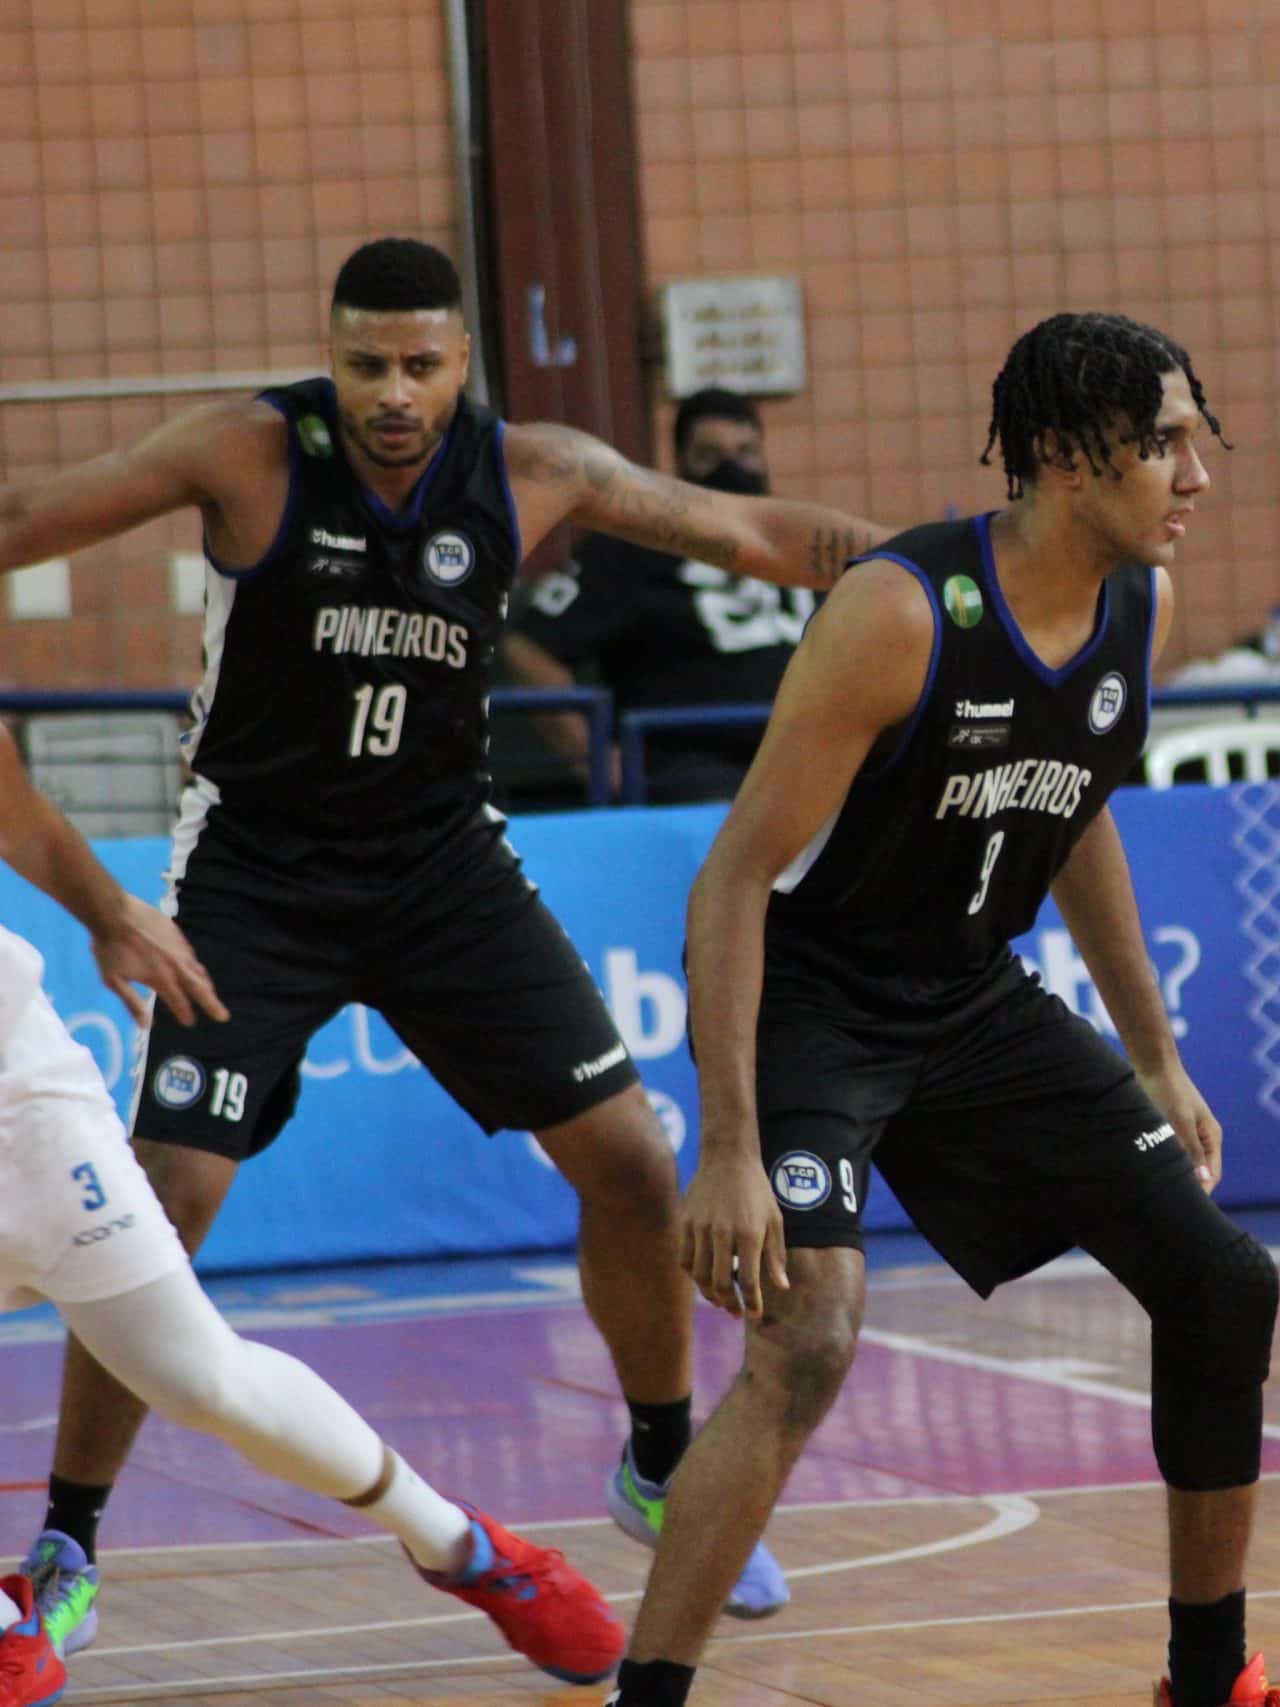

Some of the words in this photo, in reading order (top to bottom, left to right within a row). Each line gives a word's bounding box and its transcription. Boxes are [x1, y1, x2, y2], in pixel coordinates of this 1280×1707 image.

[350, 683, 408, 758] 19
[935, 759, 1092, 820] PINHEIROS
[967, 831, 1005, 916] 9
[210, 1067, 248, 1122] 19
[71, 1160, 107, 1212] 3
[838, 1157, 857, 1213] 9
